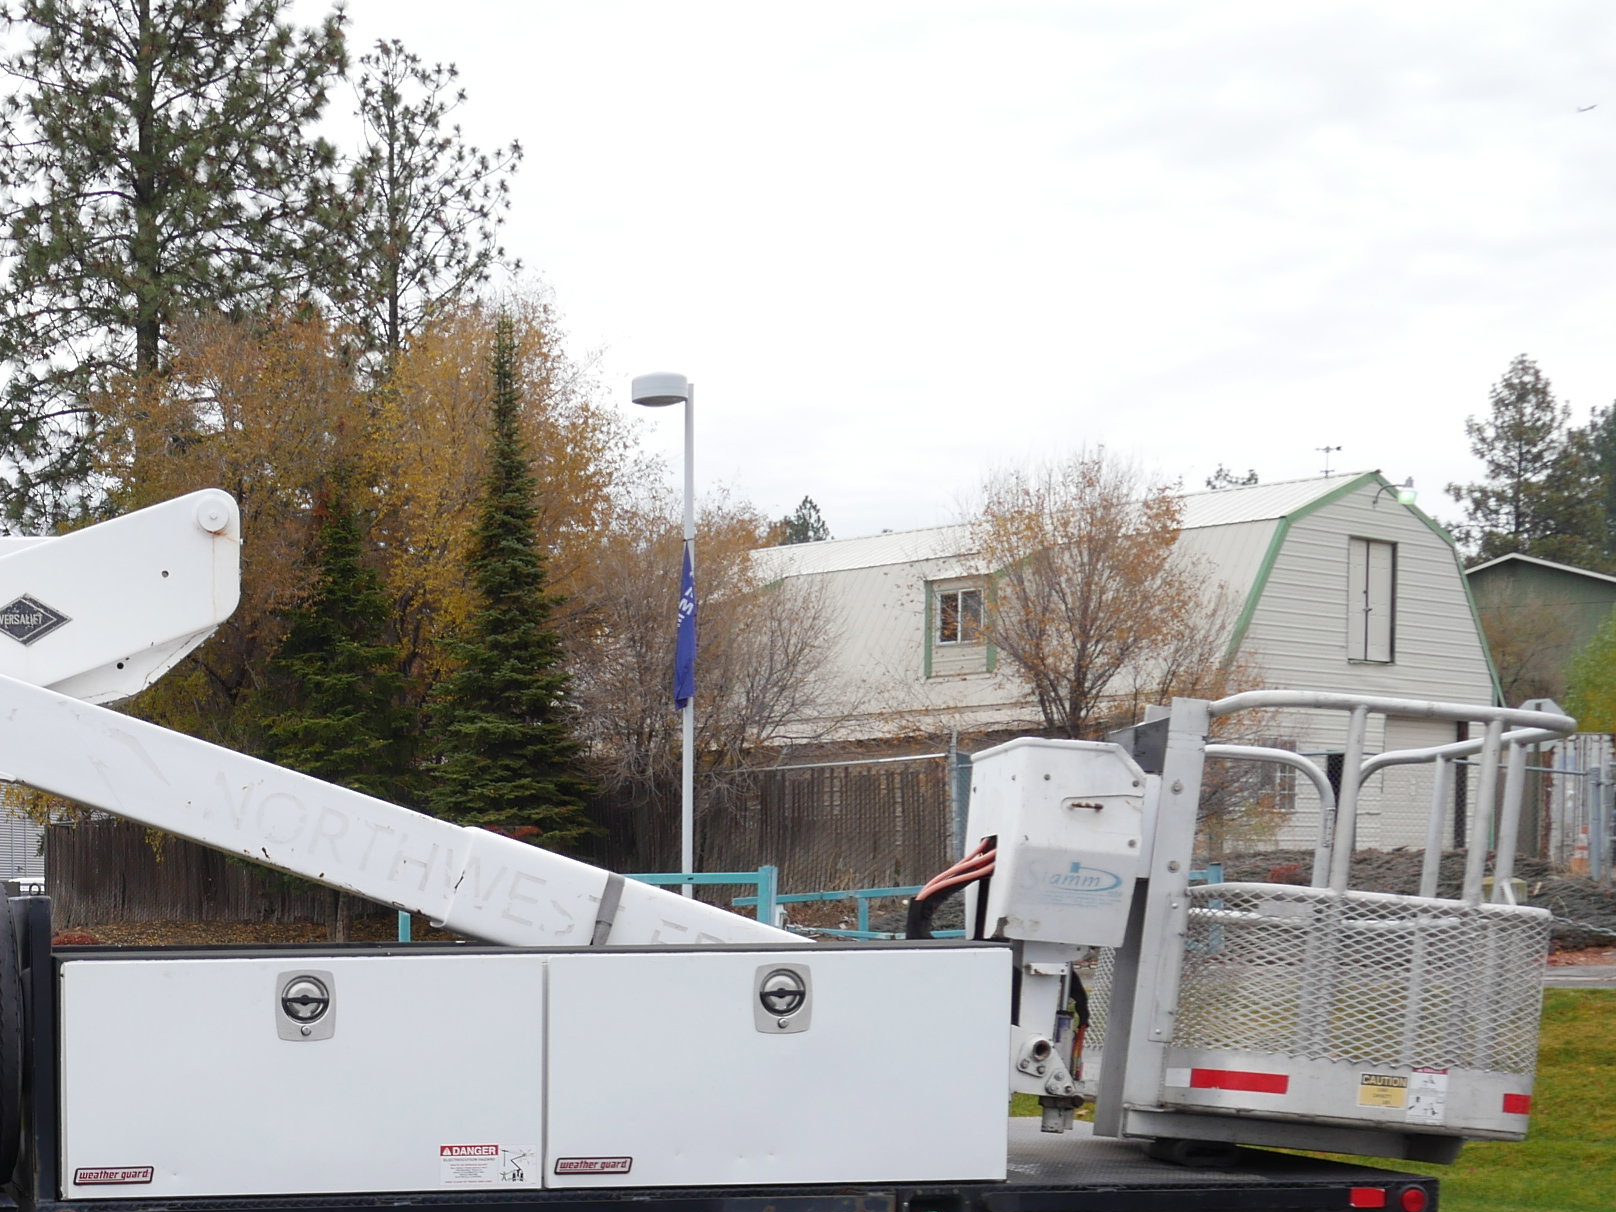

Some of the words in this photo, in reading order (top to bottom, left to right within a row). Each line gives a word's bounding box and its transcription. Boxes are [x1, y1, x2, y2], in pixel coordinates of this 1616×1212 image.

[1363, 1074, 1407, 1088] CAUTION
[452, 1146, 496, 1156] DANGER
[559, 1160, 599, 1169] weather
[600, 1159, 628, 1170] guard
[79, 1171, 119, 1180] weather
[121, 1169, 149, 1180] guard
